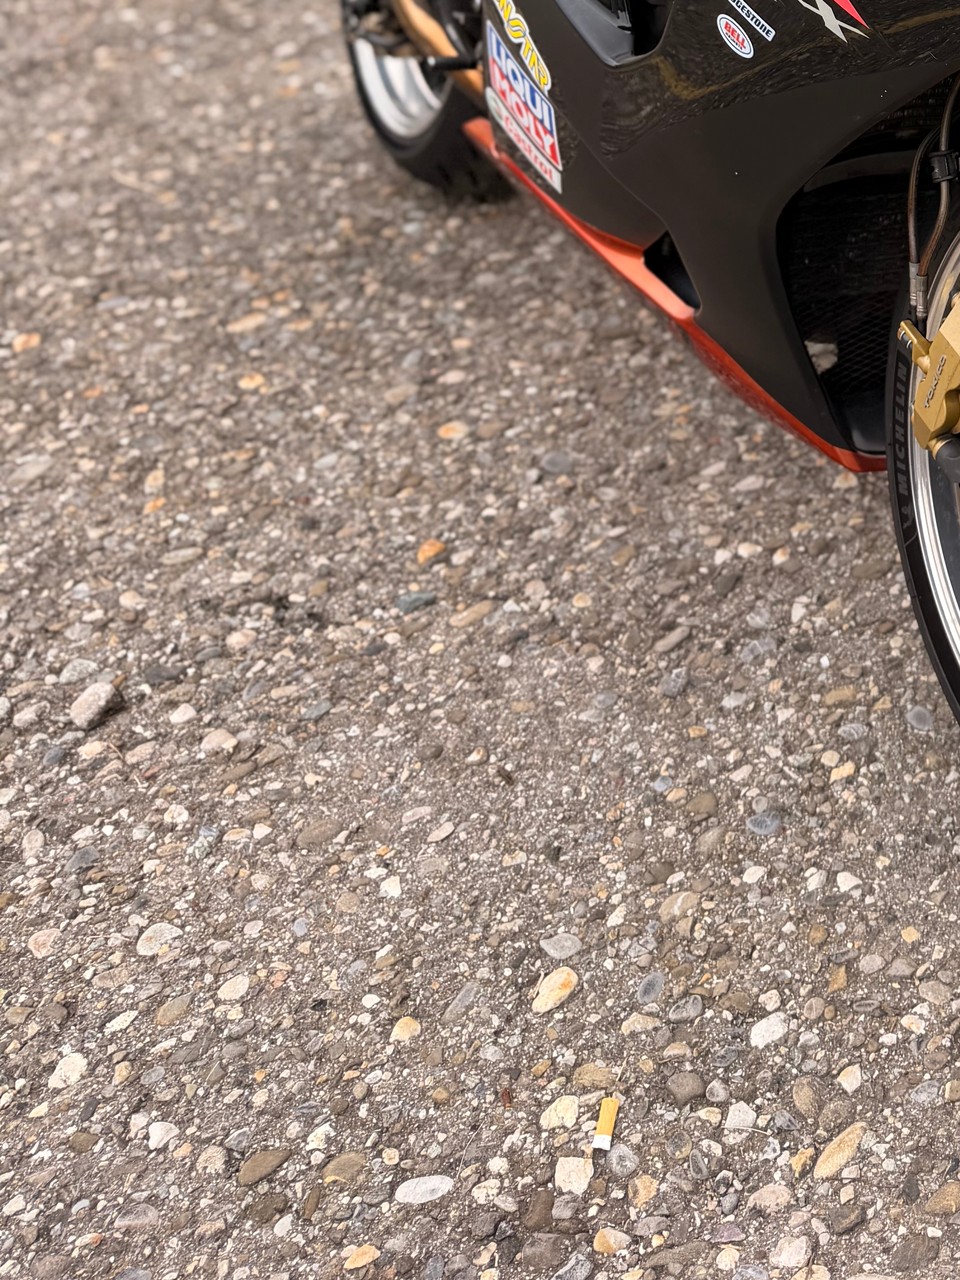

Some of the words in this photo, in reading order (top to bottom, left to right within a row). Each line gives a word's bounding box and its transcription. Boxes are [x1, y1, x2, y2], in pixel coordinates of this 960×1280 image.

[491, 30, 553, 133] LIQUI
[724, 20, 747, 50] BELL
[491, 64, 557, 161] MOLY
[894, 363, 910, 496] MICHELIN
[923, 353, 948, 410] TOKICO
